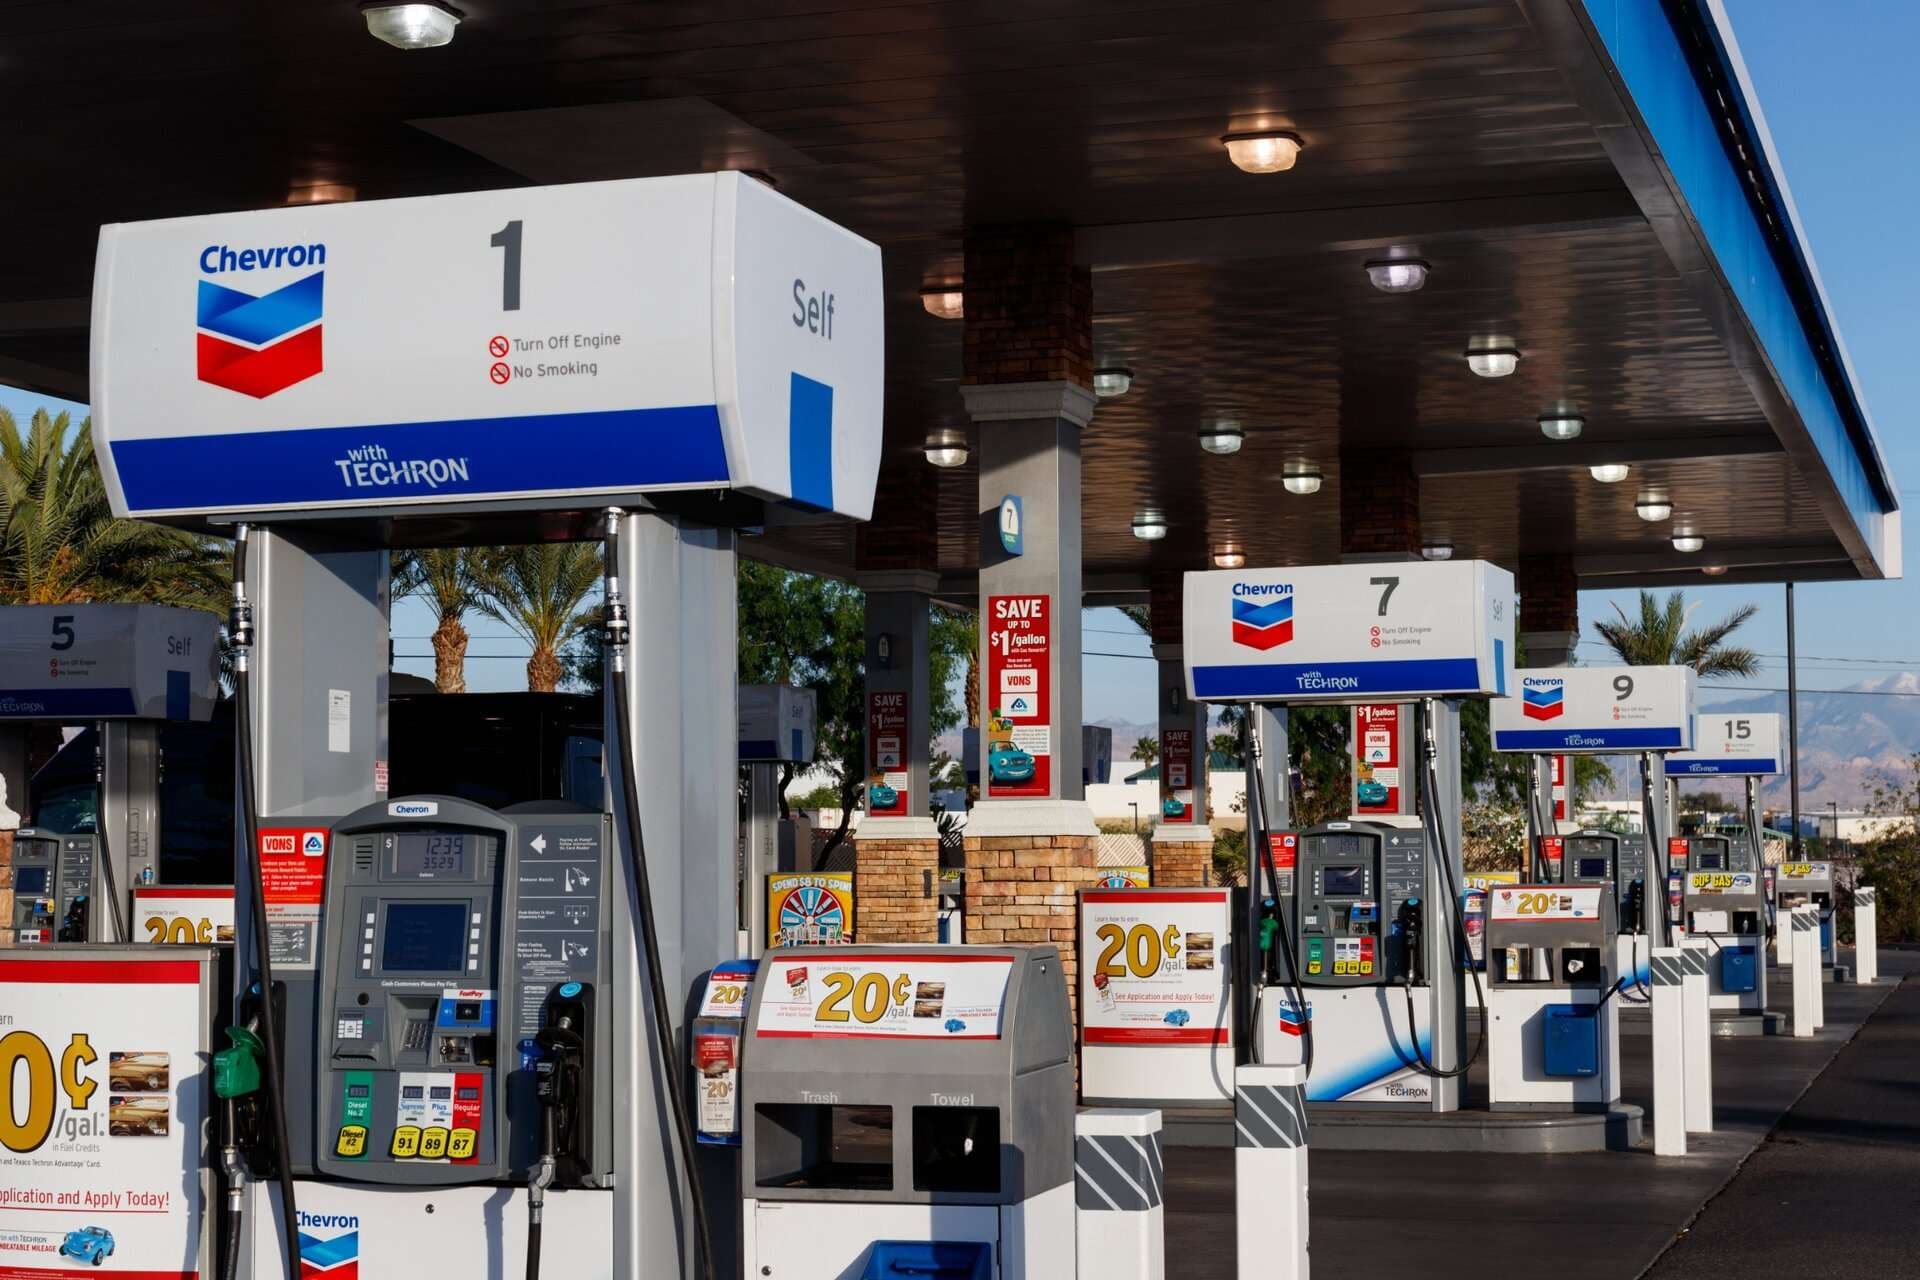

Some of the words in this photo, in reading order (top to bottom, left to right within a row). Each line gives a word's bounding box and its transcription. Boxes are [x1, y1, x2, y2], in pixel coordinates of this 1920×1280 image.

[199, 243, 326, 275] Chevron
[490, 219, 524, 312] 1
[791, 278, 834, 341] Self
[513, 336, 546, 354] Turn
[549, 334, 570, 352] Off
[573, 331, 622, 351] Engine
[513, 364, 532, 380] No
[535, 360, 599, 380] Smoking
[347, 444, 387, 464] with
[335, 457, 468, 490] TECHRON
[1006, 508, 1013, 529] 7
[1232, 582, 1294, 596] Chevron
[1369, 576, 1400, 616] 7
[996, 599, 1043, 618] SAVE
[1008, 620, 1018, 628] UP
[1019, 620, 1031, 628] TO
[1410, 626, 1432, 634] Engine
[50, 615, 75, 651] 5
[167, 635, 192, 656] Self
[1393, 638, 1421, 646] Smoking
[1008, 675, 1031, 686] VONS
[1302, 670, 1322, 679] with
[1296, 676, 1359, 690] TECHRON
[1523, 677, 1564, 687] Chevron
[1612, 675, 1634, 701] 9
[875, 695, 903, 706] SAVE
[1724, 720, 1752, 740] 15
[1564, 737, 1605, 747] TECHRON
[396, 805, 430, 815] Chevron
[264, 837, 293, 851] VONS
[385, 838, 393, 849] $
[1712, 875, 1733, 888] GAS
[1517, 893, 1558, 914] 20¢
[1095, 923, 1181, 979] 20¢
[459, 990, 484, 998] FastPay
[710, 985, 748, 1004] 20¢
[815, 972, 913, 1024] 20¢
[800, 1091, 839, 1104] Trash
[931, 1092, 974, 1106] Towel
[1385, 1087, 1428, 1099] TECHRON
[347, 1101, 368, 1109] Diesel
[454, 1103, 480, 1112] Regular
[347, 1108, 364, 1116] No.2
[342, 1130, 364, 1138] Diesel
[60, 1143, 75, 1153] Fuel
[75, 1143, 101, 1153] Credits
[345, 1137, 357, 1147] #2
[399, 1137, 413, 1149] 91
[424, 1137, 441, 1149] 89
[452, 1138, 469, 1150] 87
[57, 1190, 80, 1205] and
[84, 1190, 121, 1209] Apply
[126, 1191, 170, 1209] Today!
[20, 1235, 47, 1243] TECHRON
[31, 1244, 57, 1253] MILEAGE
